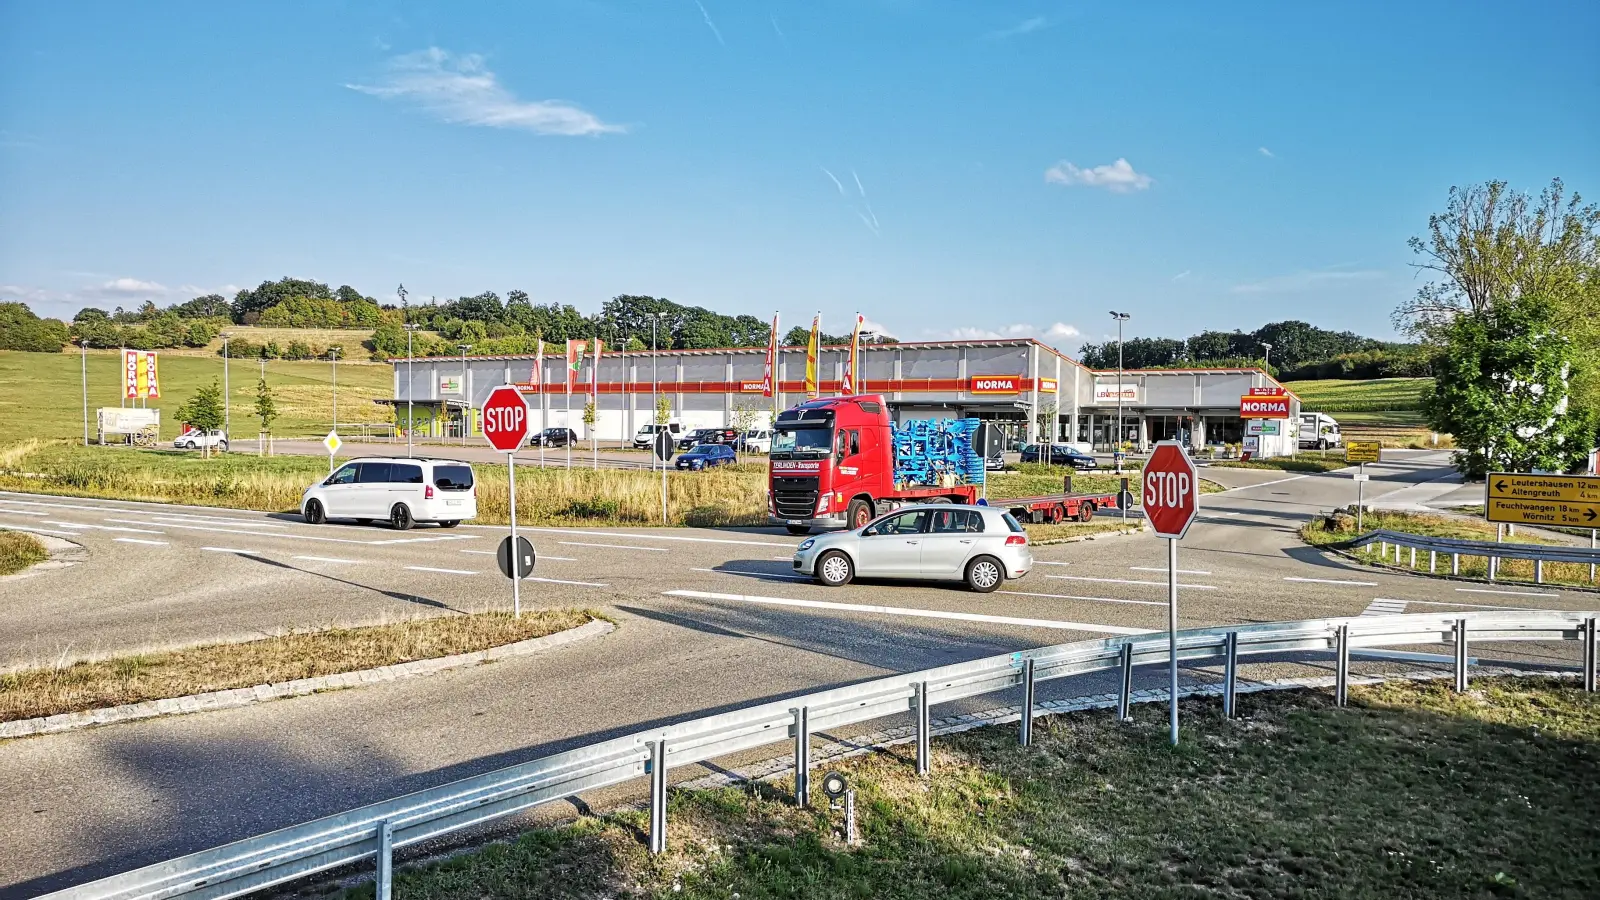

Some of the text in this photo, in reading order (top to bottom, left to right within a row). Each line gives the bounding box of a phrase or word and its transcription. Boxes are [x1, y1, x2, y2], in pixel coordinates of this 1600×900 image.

[127, 354, 137, 395] NORMA
[147, 355, 157, 395] NORMA
[976, 380, 1013, 389] NORMA
[1242, 402, 1286, 412] NORMA
[486, 405, 524, 433] STOP
[1511, 479, 1574, 489] Leutershausen
[1577, 481, 1587, 489] 12
[1146, 471, 1190, 509] STOP
[1511, 488, 1561, 498] Altengreuth
[1580, 491, 1586, 499] 4
[1496, 501, 1556, 512] Feuchtwangen
[1559, 504, 1568, 512] 18
[1522, 511, 1555, 521] Wörnitz
[1562, 514, 1567, 522] 5
